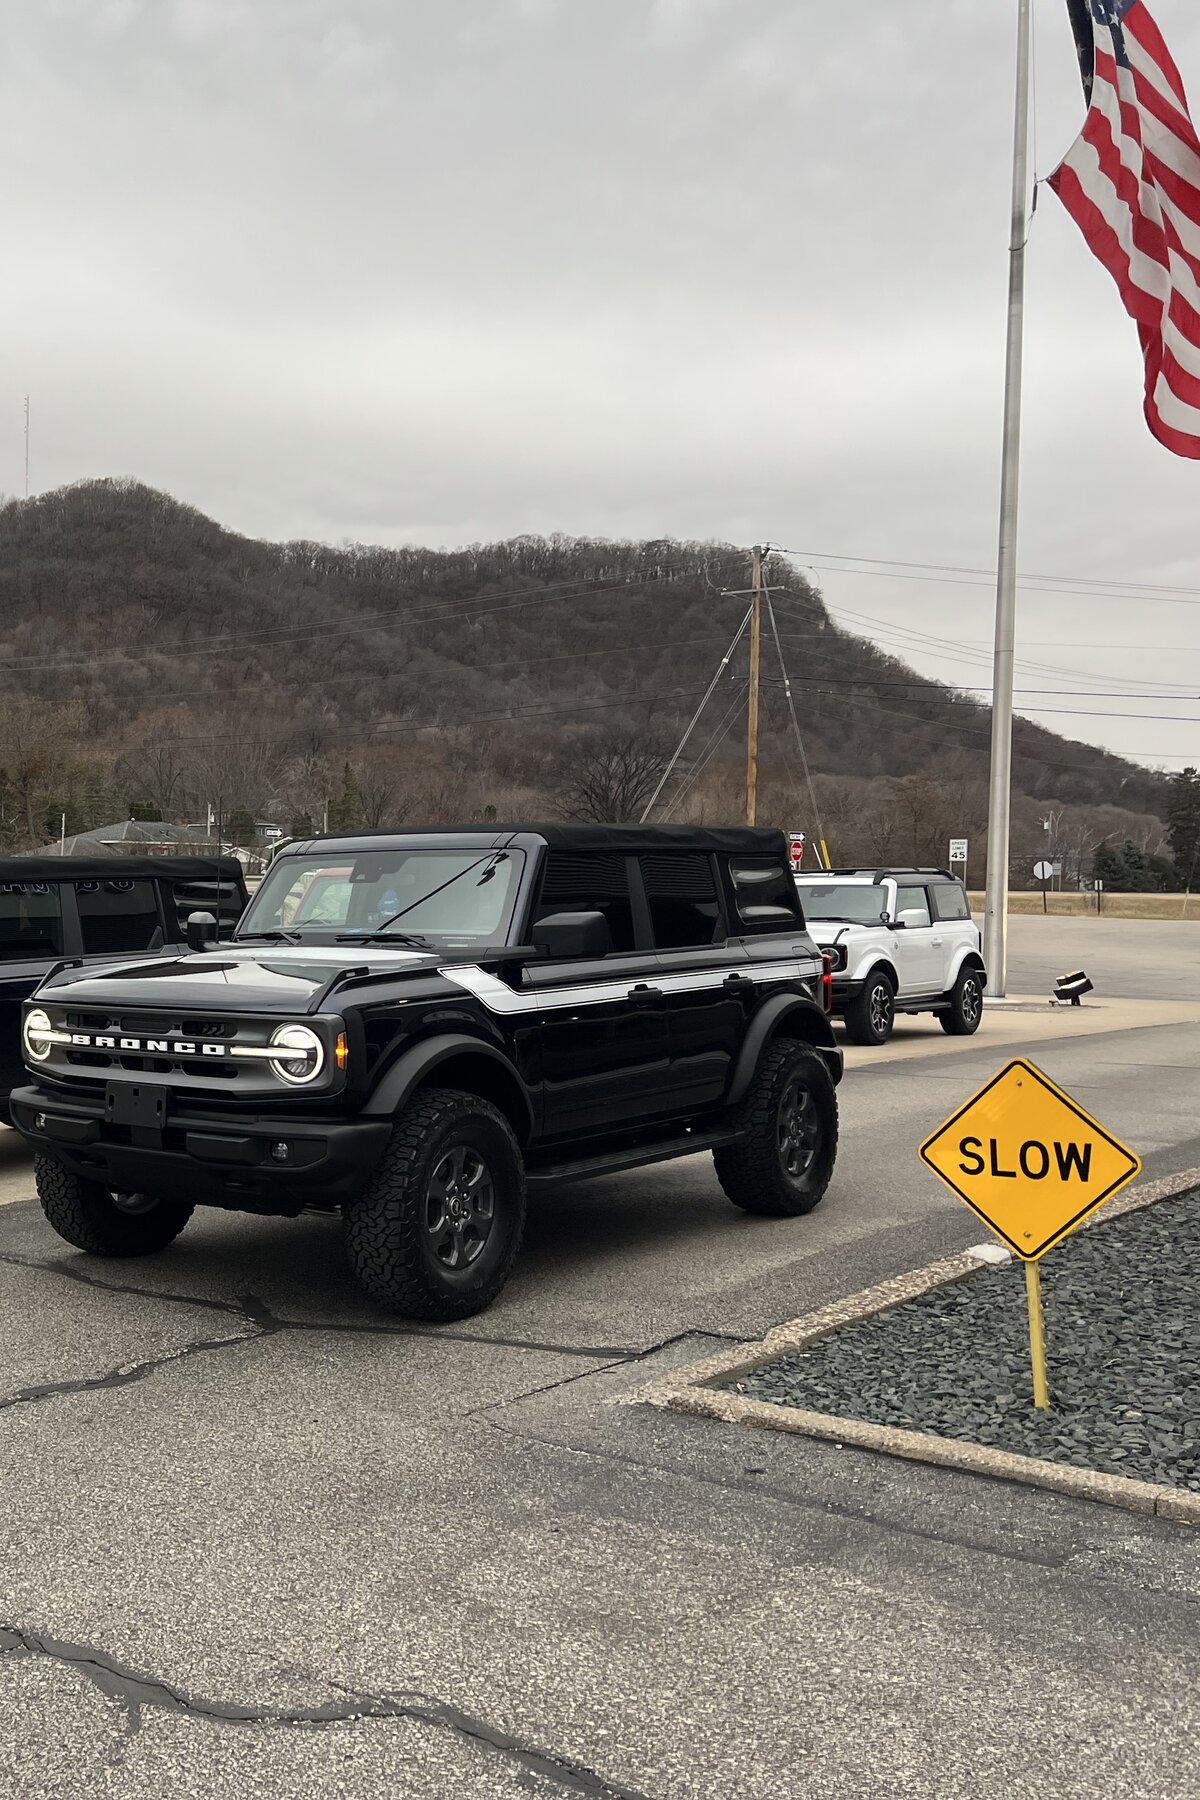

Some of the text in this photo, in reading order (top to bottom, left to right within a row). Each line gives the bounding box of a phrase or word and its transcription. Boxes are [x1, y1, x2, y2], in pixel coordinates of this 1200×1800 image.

[951, 851, 965, 859] 45
[72, 1035, 225, 1056] BRONCO
[958, 1136, 1092, 1182] SLOW
